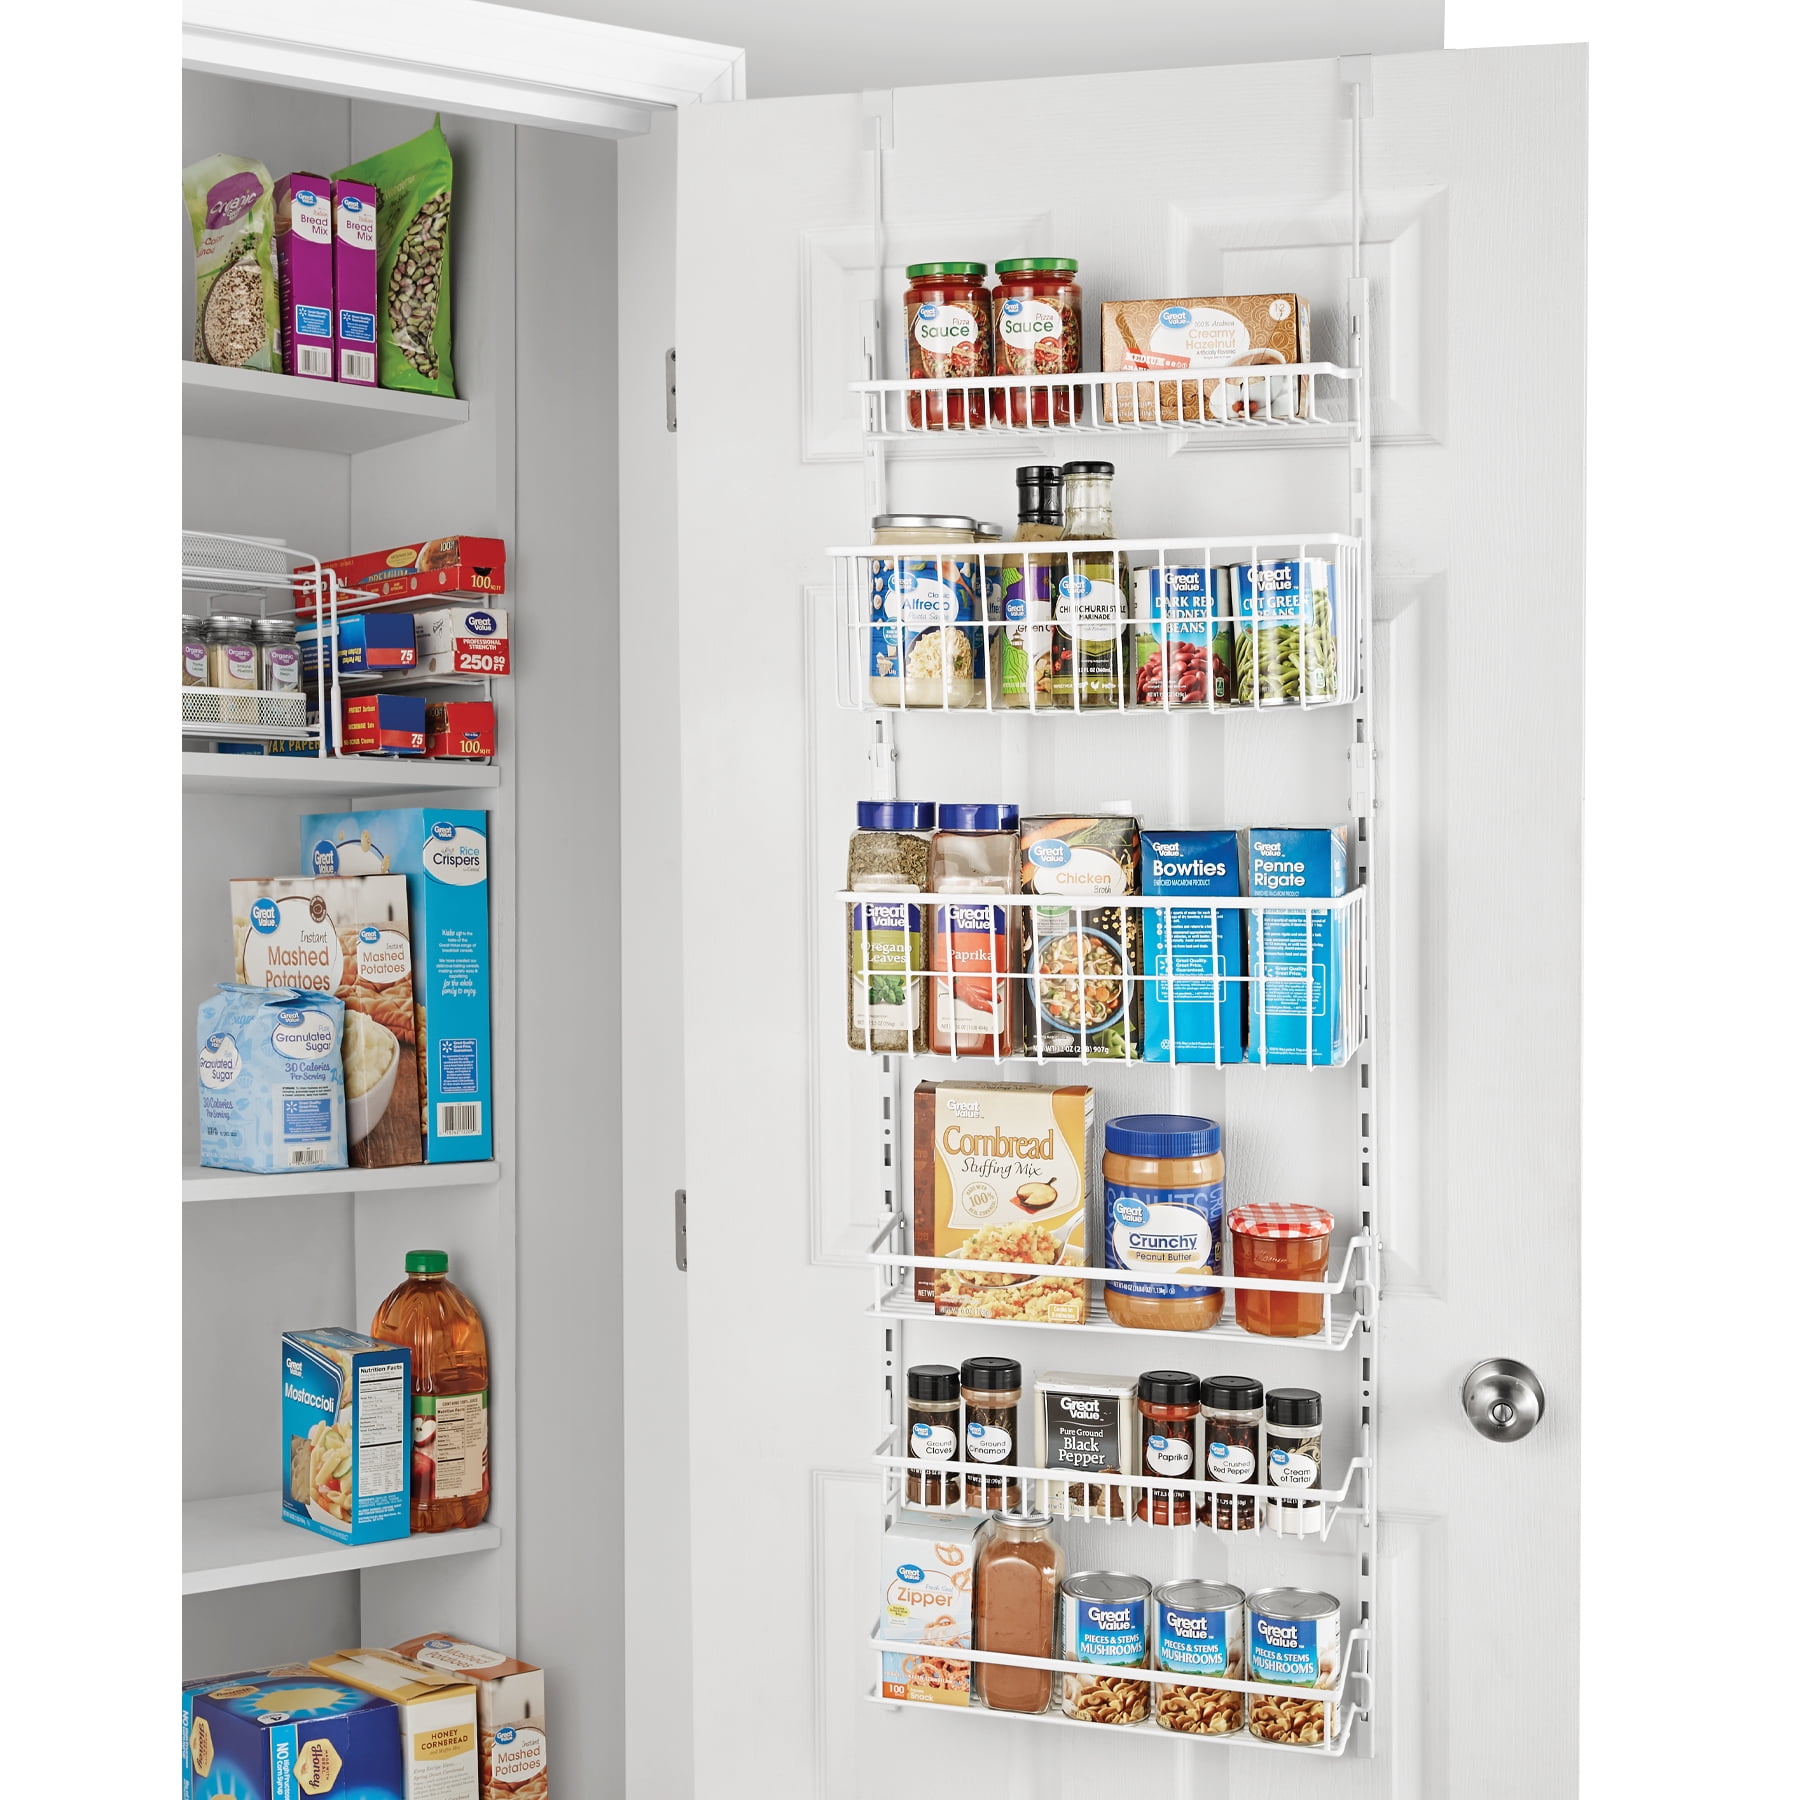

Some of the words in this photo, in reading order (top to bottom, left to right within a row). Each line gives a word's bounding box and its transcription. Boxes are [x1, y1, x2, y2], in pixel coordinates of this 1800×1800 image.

[300, 214, 328, 226] Bread
[312, 225, 328, 236] Mix
[346, 220, 373, 233] Bread
[357, 231, 373, 241] Mix
[952, 317, 970, 326] Pizza
[1035, 312, 1054, 321] Pizza
[1163, 311, 1186, 320] Great
[921, 324, 970, 339] Sauce
[1005, 319, 1054, 334] Sauce
[1188, 328, 1236, 340] Creamy
[1185, 339, 1236, 350] Hazelnut
[368, 570, 408, 583] PREMIUM
[1165, 572, 1200, 585] Great
[1247, 565, 1292, 584] Great
[471, 575, 491, 589] 100
[1173, 582, 1200, 591] Value
[1258, 580, 1292, 591] Value
[1008, 604, 1024, 612] Great
[1155, 596, 1191, 608] DARK
[1165, 609, 1208, 619] KIDNEY
[468, 617, 491, 626] Great
[1166, 622, 1206, 633] BEANS
[474, 624, 492, 632] Value
[228, 648, 251, 657] Organic
[271, 651, 294, 661] Organic
[400, 649, 413, 661] 75
[460, 653, 492, 671] 250
[494, 656, 505, 665] SQ
[494, 663, 504, 671] FT
[411, 734, 423, 745] 75
[289, 740, 320, 752] PAPER
[459, 740, 481, 754] 100
[459, 846, 480, 856] Rice
[1034, 845, 1065, 857] Great
[1152, 842, 1180, 852] Great
[1254, 841, 1281, 852] Great
[1260, 848, 1281, 857] Value
[314, 849, 334, 866] Great
[1040, 854, 1065, 863] Value
[1159, 849, 1180, 857] Value
[433, 853, 480, 868] Crispers
[1254, 859, 1305, 873] Penne
[317, 862, 337, 874] Value
[1153, 860, 1226, 877] Bowties
[1056, 872, 1112, 885] Chicken
[1153, 879, 1172, 887] ENRICHED
[1171, 879, 1193, 887] MACARONI
[1192, 879, 1210, 887] PRODUCT
[1254, 872, 1305, 890] Rigate
[1094, 884, 1112, 894] Broth
[252, 905, 276, 920] Great
[864, 903, 905, 918] Great
[949, 905, 991, 920] Great
[258, 916, 277, 927] Value
[872, 916, 906, 927] Value
[957, 918, 991, 930] Value
[300, 929, 328, 944] Instant
[360, 931, 377, 939] Great
[268, 946, 330, 967] Mashed
[362, 951, 405, 963] Mashed
[951, 949, 993, 963] Paprika
[360, 962, 406, 975] Potatoes
[265, 969, 331, 992] Potatoes
[280, 1012, 300, 1020] Great
[275, 1031, 332, 1043] Granulated
[305, 1042, 331, 1053] Sugar
[1093, 1045, 1109, 1054] 907g
[284, 1062, 298, 1073] 30
[299, 1061, 331, 1072] Calories
[211, 1069, 234, 1082] Sugar
[289, 1072, 303, 1081] Per
[303, 1071, 327, 1081] Serving
[210, 1097, 234, 1109] Calories
[947, 1099, 980, 1112] Great
[955, 1109, 980, 1119] Value
[943, 1125, 1054, 1160] Cornbread
[961, 1157, 1012, 1179] Stuffing
[1015, 1161, 1043, 1177] Mix
[969, 1192, 995, 1207] 100%
[1117, 1203, 1143, 1217] Great
[1122, 1213, 1144, 1223] Value
[1129, 1233, 1198, 1250] Crunchy
[1136, 1252, 1166, 1262] Peanut
[1167, 1253, 1192, 1262] Butter
[286, 1358, 303, 1371] Great
[360, 1366, 386, 1374] Nutrition
[285, 1382, 335, 1414] Mostaccioli
[1060, 1396, 1100, 1413] Great
[1070, 1409, 1100, 1420] Value
[1059, 1428, 1076, 1437] Pure
[1076, 1428, 1104, 1438] Ground
[968, 1445, 1006, 1455] Cinnamon
[1064, 1436, 1099, 1452] Black
[925, 1447, 953, 1455] Cloves
[1058, 1449, 1105, 1466] Pepper
[1157, 1452, 1189, 1463] Paprika
[1226, 1466, 1250, 1475] Pepper
[1283, 1468, 1311, 1476] Cream
[1289, 1475, 1311, 1483] Tartar
[899, 1567, 919, 1577] Great
[897, 1586, 953, 1607] Zipper
[1088, 1607, 1130, 1622] Great
[1098, 1619, 1131, 1631] Value
[1166, 1612, 1208, 1630] Great
[1175, 1627, 1208, 1640] Value
[1257, 1620, 1298, 1639] Great
[1084, 1634, 1110, 1644] PIECES
[1109, 1635, 1116, 1643] &
[1117, 1634, 1140, 1643] STEMS
[1265, 1635, 1298, 1648] Value
[1080, 1642, 1143, 1655] MUSHROOMS
[1164, 1640, 1187, 1652] PIECES
[1186, 1643, 1193, 1651] &
[1193, 1643, 1219, 1653] STEMS
[1161, 1648, 1223, 1665] MUSHROOMS
[1255, 1646, 1277, 1660] PIECES
[1276, 1652, 1283, 1660] &
[1284, 1653, 1310, 1663] STEMS
[1252, 1655, 1314, 1674] MUSHROOMS
[889, 1684, 905, 1694] 100
[910, 1693, 934, 1702] Snack
[182, 1710, 189, 1728] NO
[431, 1729, 458, 1741] HONEY
[497, 1731, 513, 1739] Great
[421, 1736, 469, 1751] CORNBREAD
[521, 1739, 540, 1748] Instant
[276, 1742, 289, 1759] NO
[498, 1746, 541, 1764] Mashed
[276, 1759, 284, 1776] Corn
[309, 1744, 323, 1788] Honey
[495, 1759, 541, 1776] Potatoes
[275, 1776, 284, 1795] Syrup
